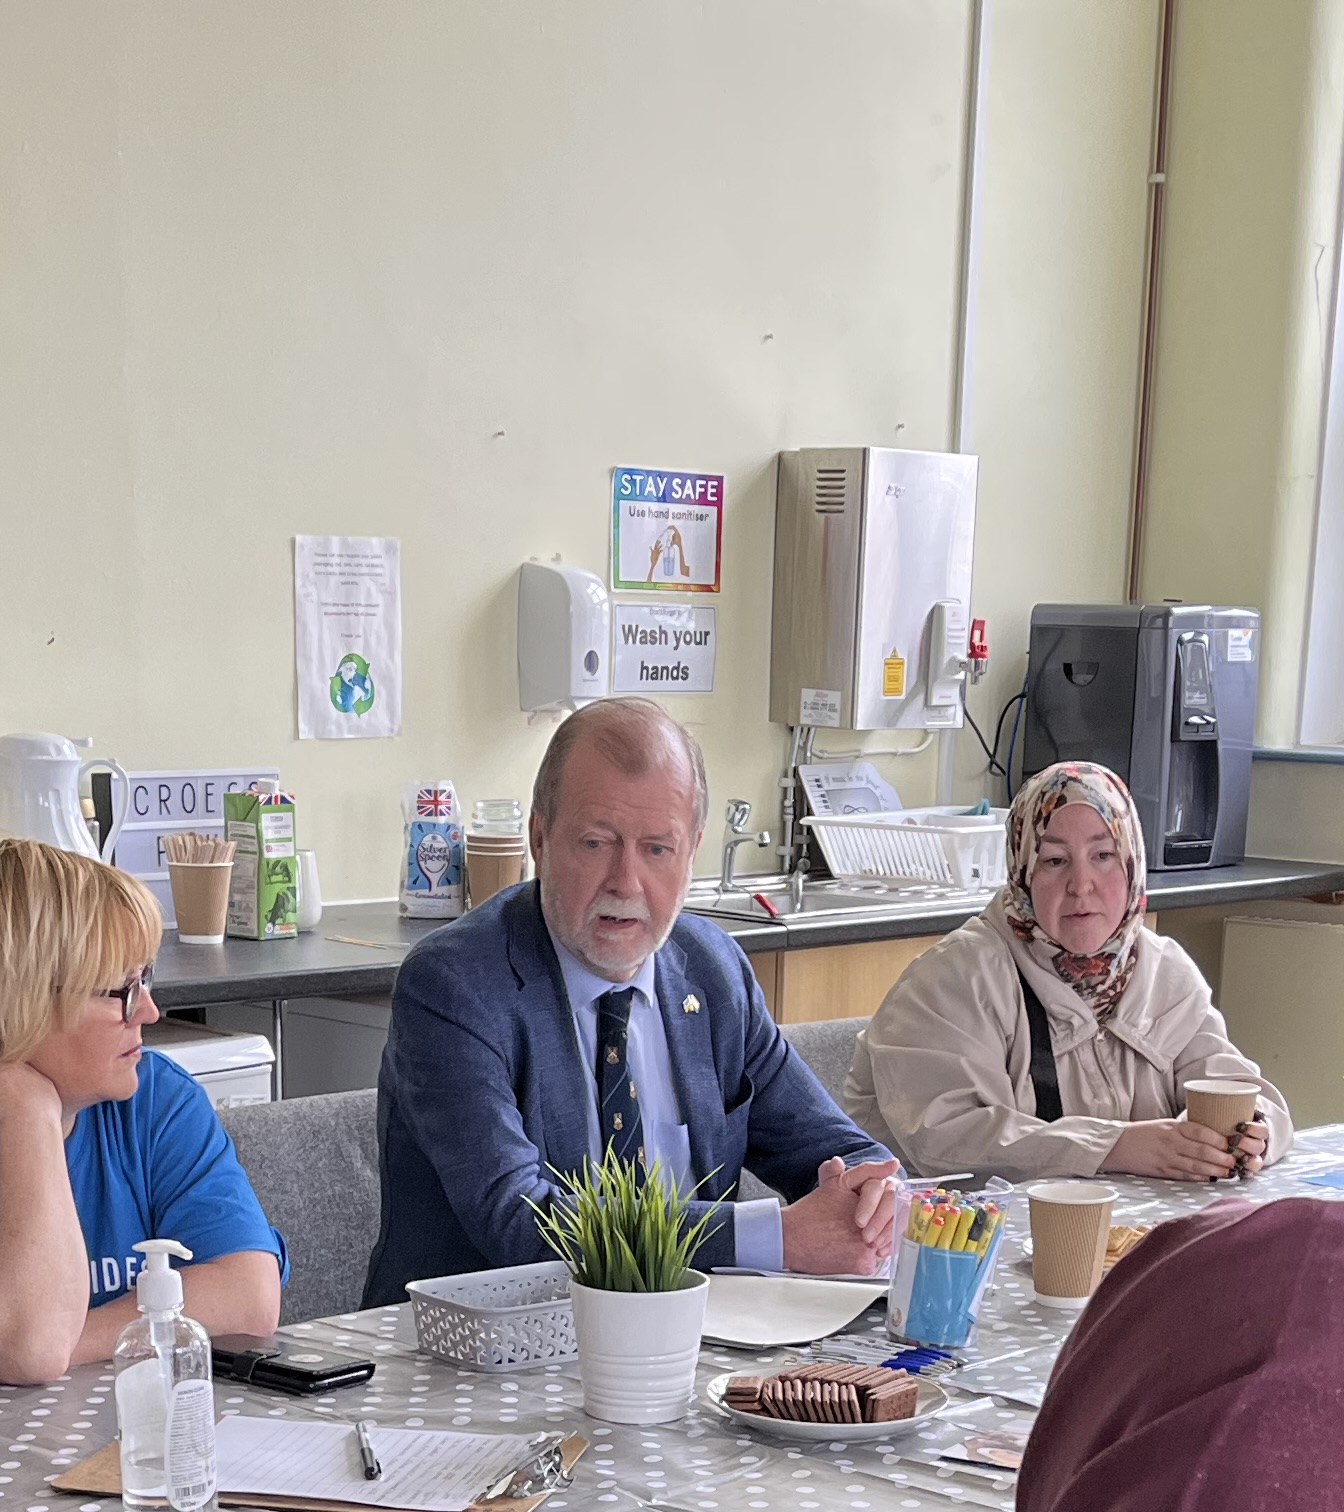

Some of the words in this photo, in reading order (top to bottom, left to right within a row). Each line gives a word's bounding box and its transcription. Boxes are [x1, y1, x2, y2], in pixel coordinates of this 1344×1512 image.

[620, 474, 668, 498] STAY
[671, 477, 719, 501] SAFE
[628, 505, 646, 518] Use
[647, 506, 670, 520] hand
[671, 509, 710, 522] sanitiser
[621, 624, 669, 646] Wash
[673, 630, 711, 651] your
[639, 660, 690, 681] hands
[134, 781, 258, 816] CROE
[419, 842, 448, 855] Silver
[419, 853, 451, 865] Spoon
